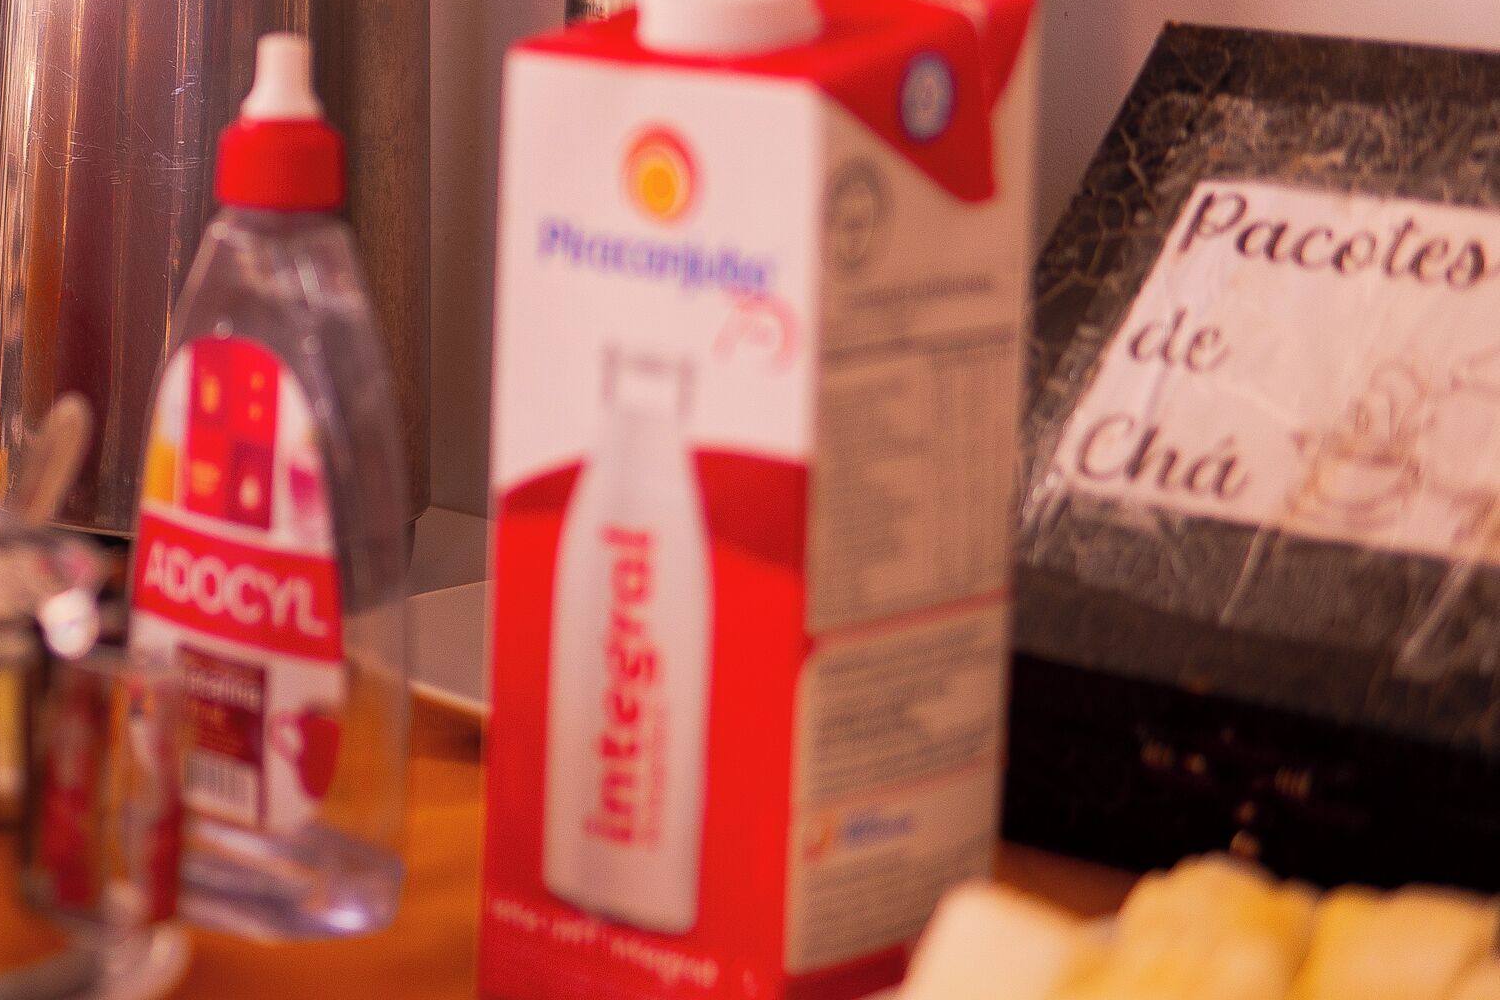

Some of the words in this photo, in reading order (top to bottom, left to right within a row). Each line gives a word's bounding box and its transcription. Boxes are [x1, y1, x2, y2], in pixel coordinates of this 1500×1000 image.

[1176, 190, 1492, 290] Pacotes
[1128, 308, 1230, 373] de
[1075, 411, 1249, 499] Chá
[142, 540, 328, 640] ADOCYL
